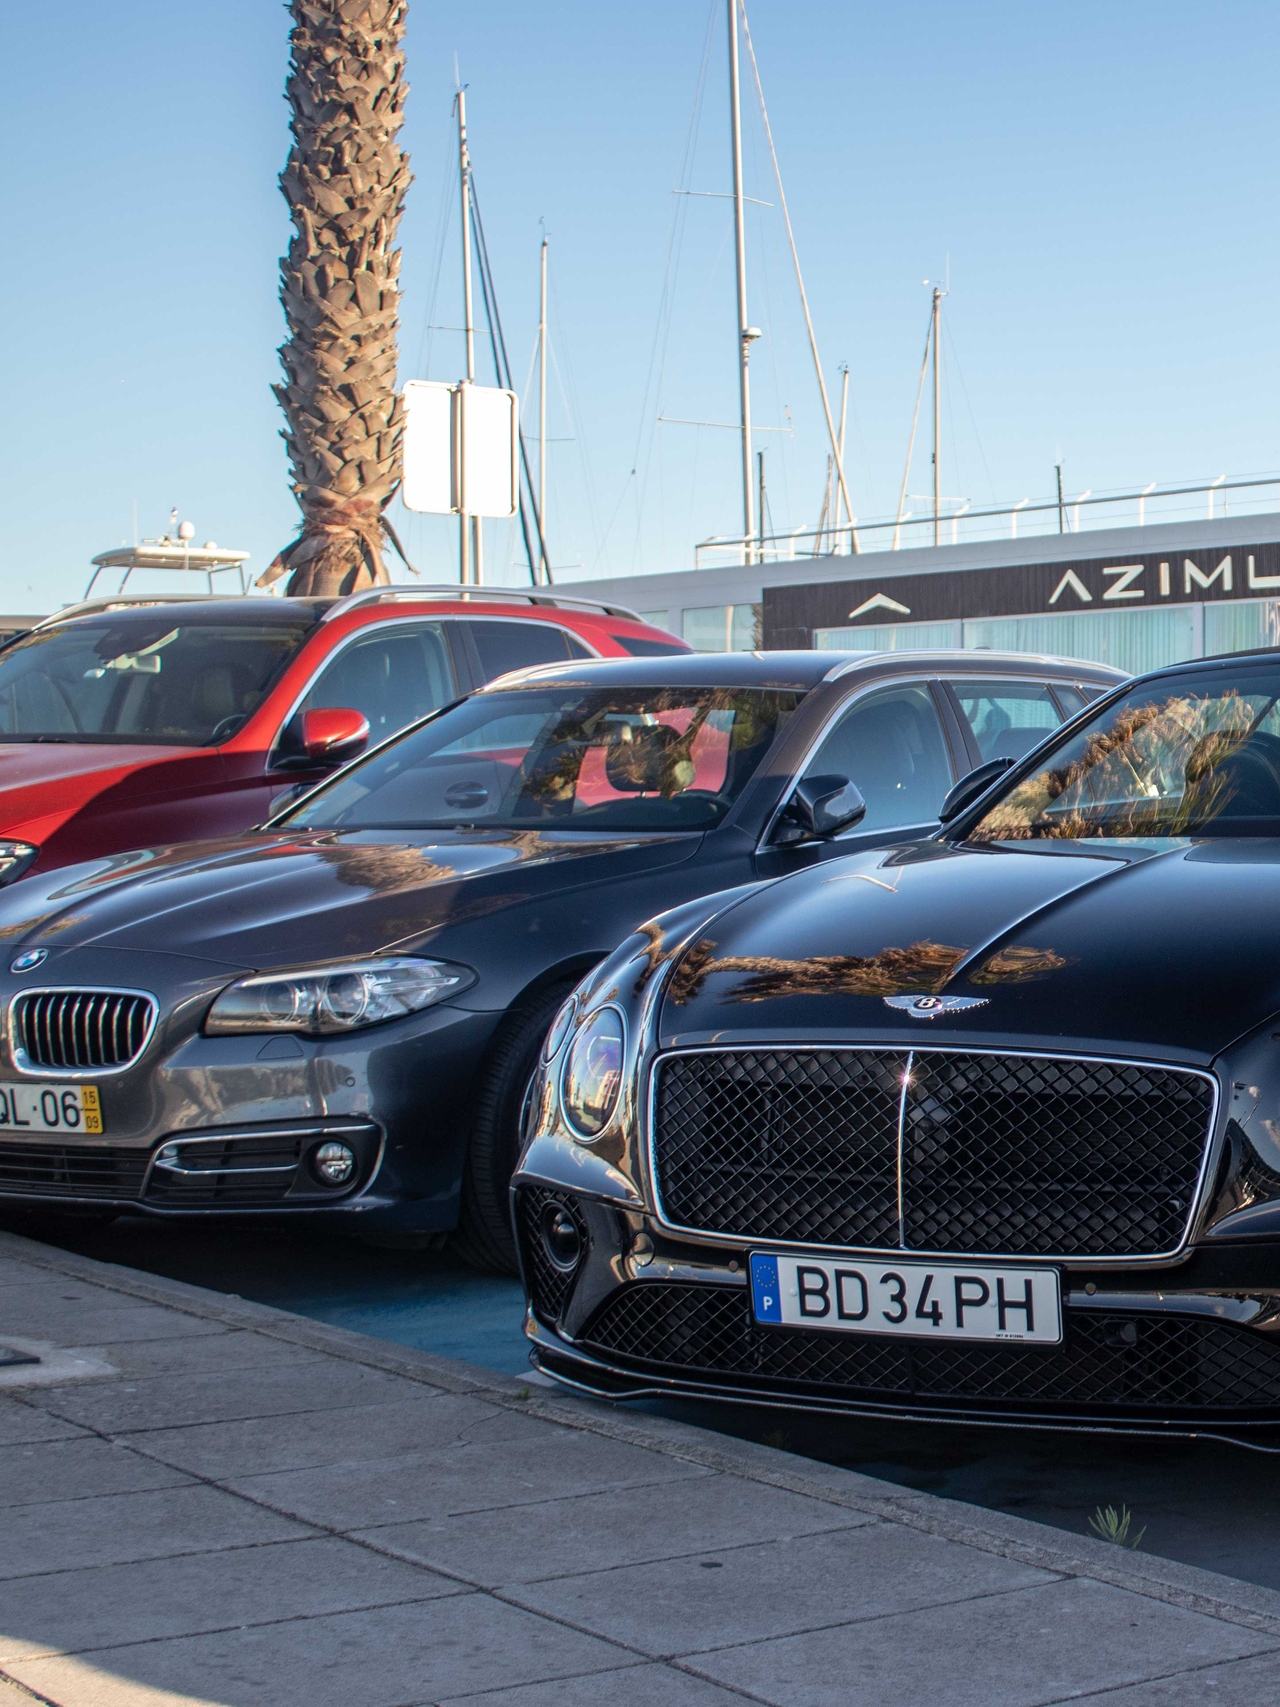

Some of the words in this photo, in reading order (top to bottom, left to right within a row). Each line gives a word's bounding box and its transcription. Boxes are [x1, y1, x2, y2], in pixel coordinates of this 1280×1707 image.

[83, 1090, 96, 1104] 15
[86, 1115, 99, 1129] 09
[763, 1296, 773, 1311] P
